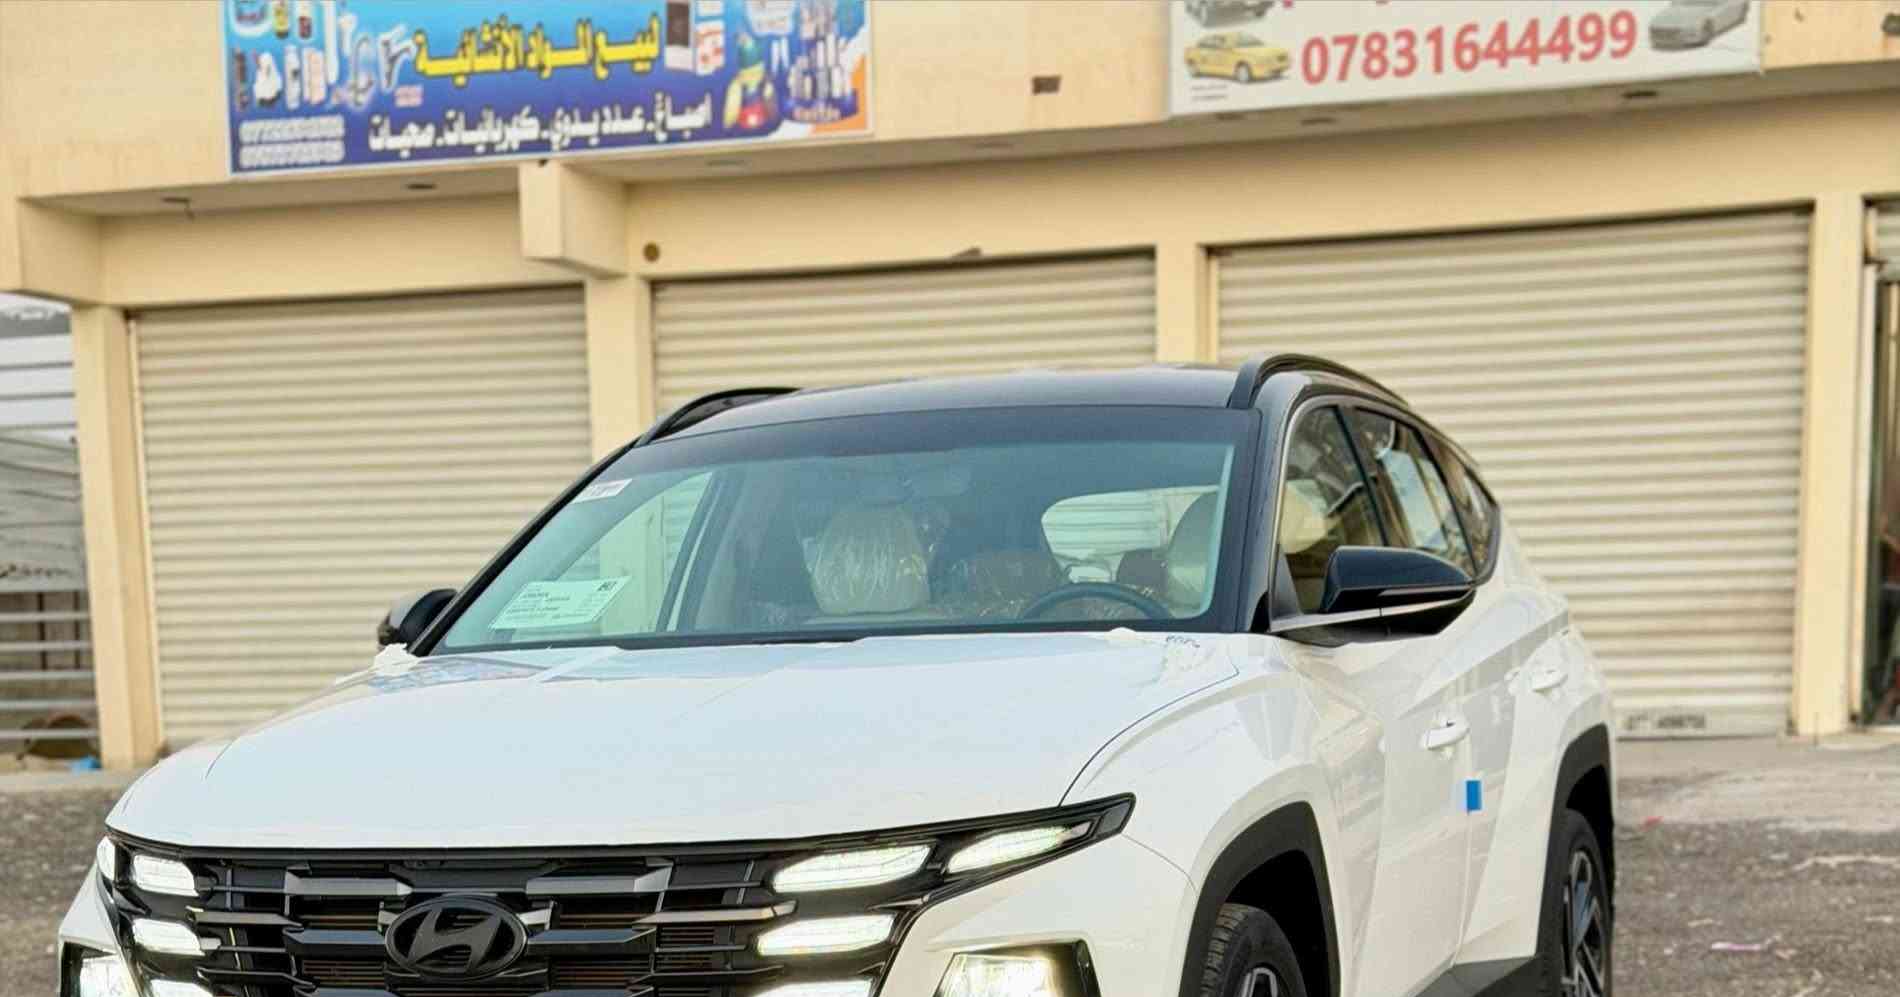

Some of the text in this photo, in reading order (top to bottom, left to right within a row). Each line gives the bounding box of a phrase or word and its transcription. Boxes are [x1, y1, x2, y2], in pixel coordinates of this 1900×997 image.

[527, 18, 592, 78] المواد
[594, 13, 660, 79] لبيع
[1302, 10, 1638, 84] 07831644499
